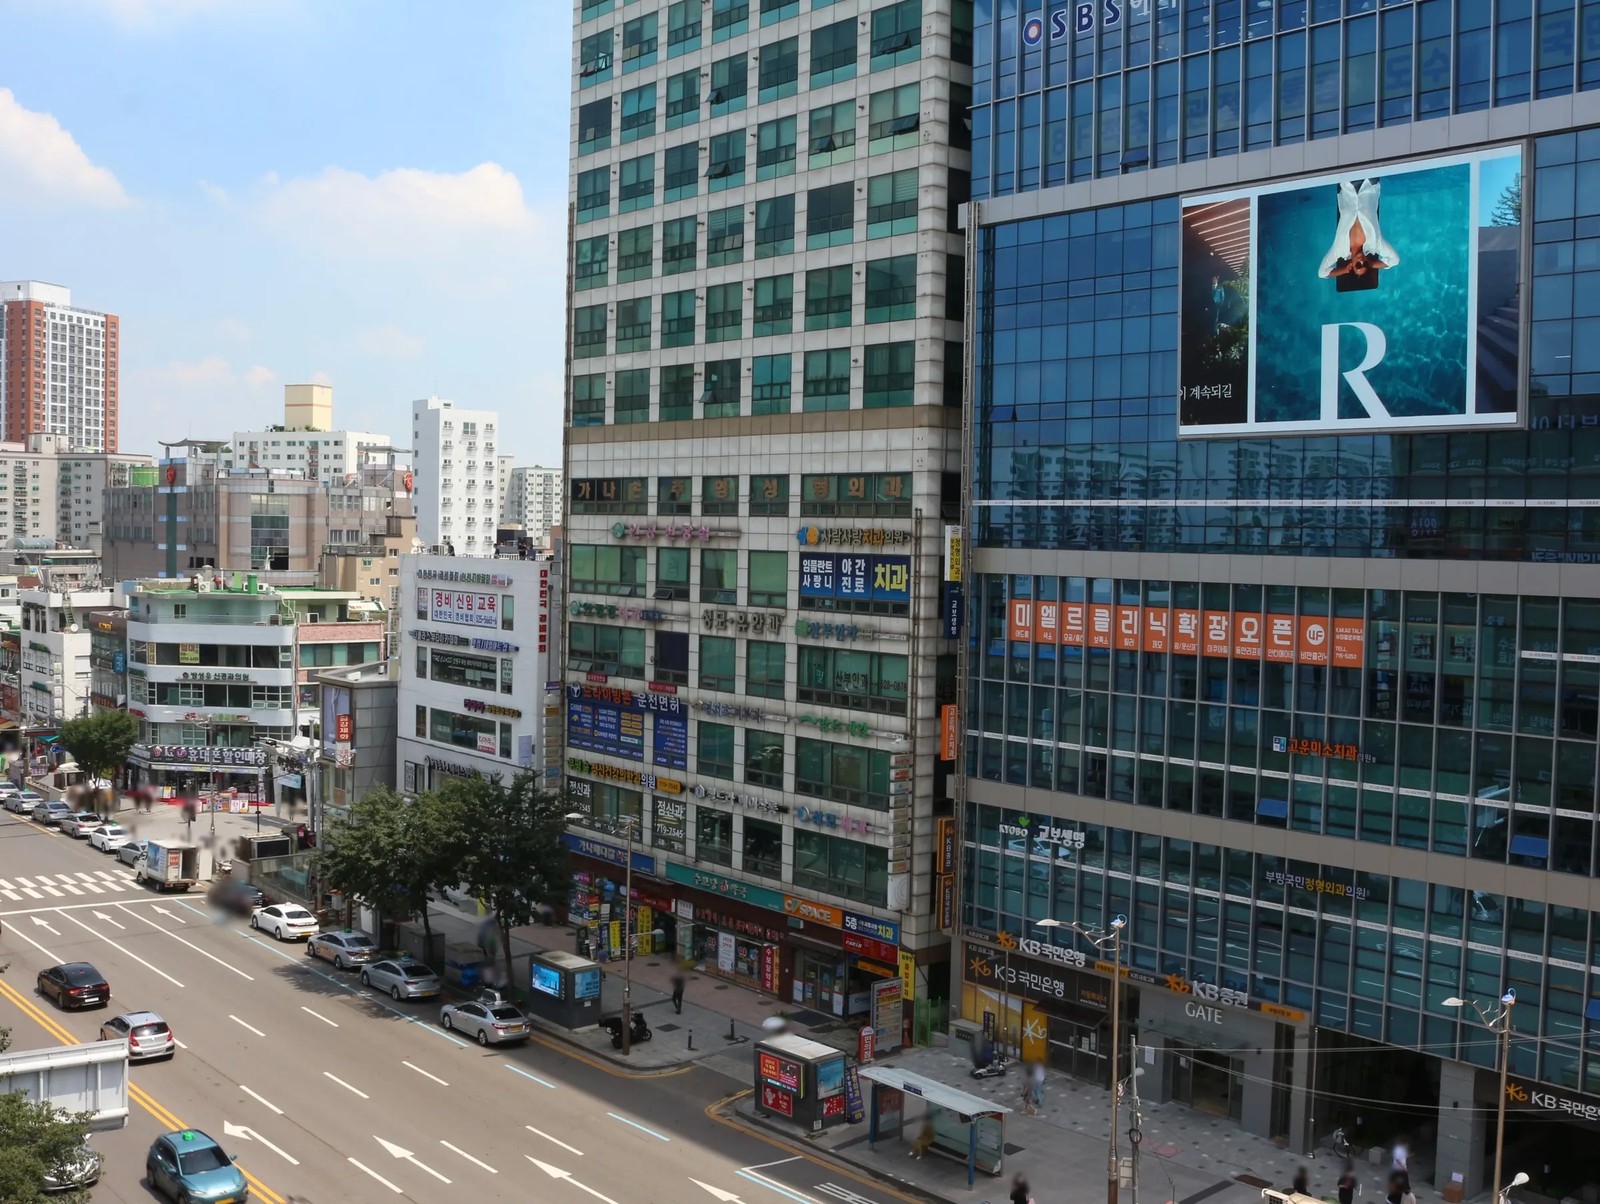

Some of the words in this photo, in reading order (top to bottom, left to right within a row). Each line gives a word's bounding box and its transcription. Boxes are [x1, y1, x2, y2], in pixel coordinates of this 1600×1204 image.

[1051, 0, 1120, 40] SBS
[1320, 322, 1392, 419] R
[1189, 383, 1232, 400] 계속되길
[822, 528, 905, 545] 사람사랑치과의원
[803, 560, 832, 573] 임플란트
[842, 559, 865, 575] 야간
[874, 563, 908, 592] 치과
[803, 575, 832, 588] 사랑니
[842, 577, 864, 593] 진료
[435, 592, 452, 608] 경비
[456, 594, 473, 610] 신임
[477, 596, 496, 613] 교육
[638, 691, 680, 714] 운전면허
[569, 781, 591, 798] 정신과
[999, 824, 1029, 837] KYOBO
[1039, 825, 1085, 849] 교보생명
[1265, 870, 1366, 900] 부평국민정형외과의원
[800, 903, 831, 922] SPACE
[845, 916, 858, 931] 5층
[877, 924, 893, 940] 치과
[1019, 937, 1086, 968] KB국민은행
[1185, 1001, 1223, 1024] GATE
[1531, 1091, 1600, 1121] KB국민은
